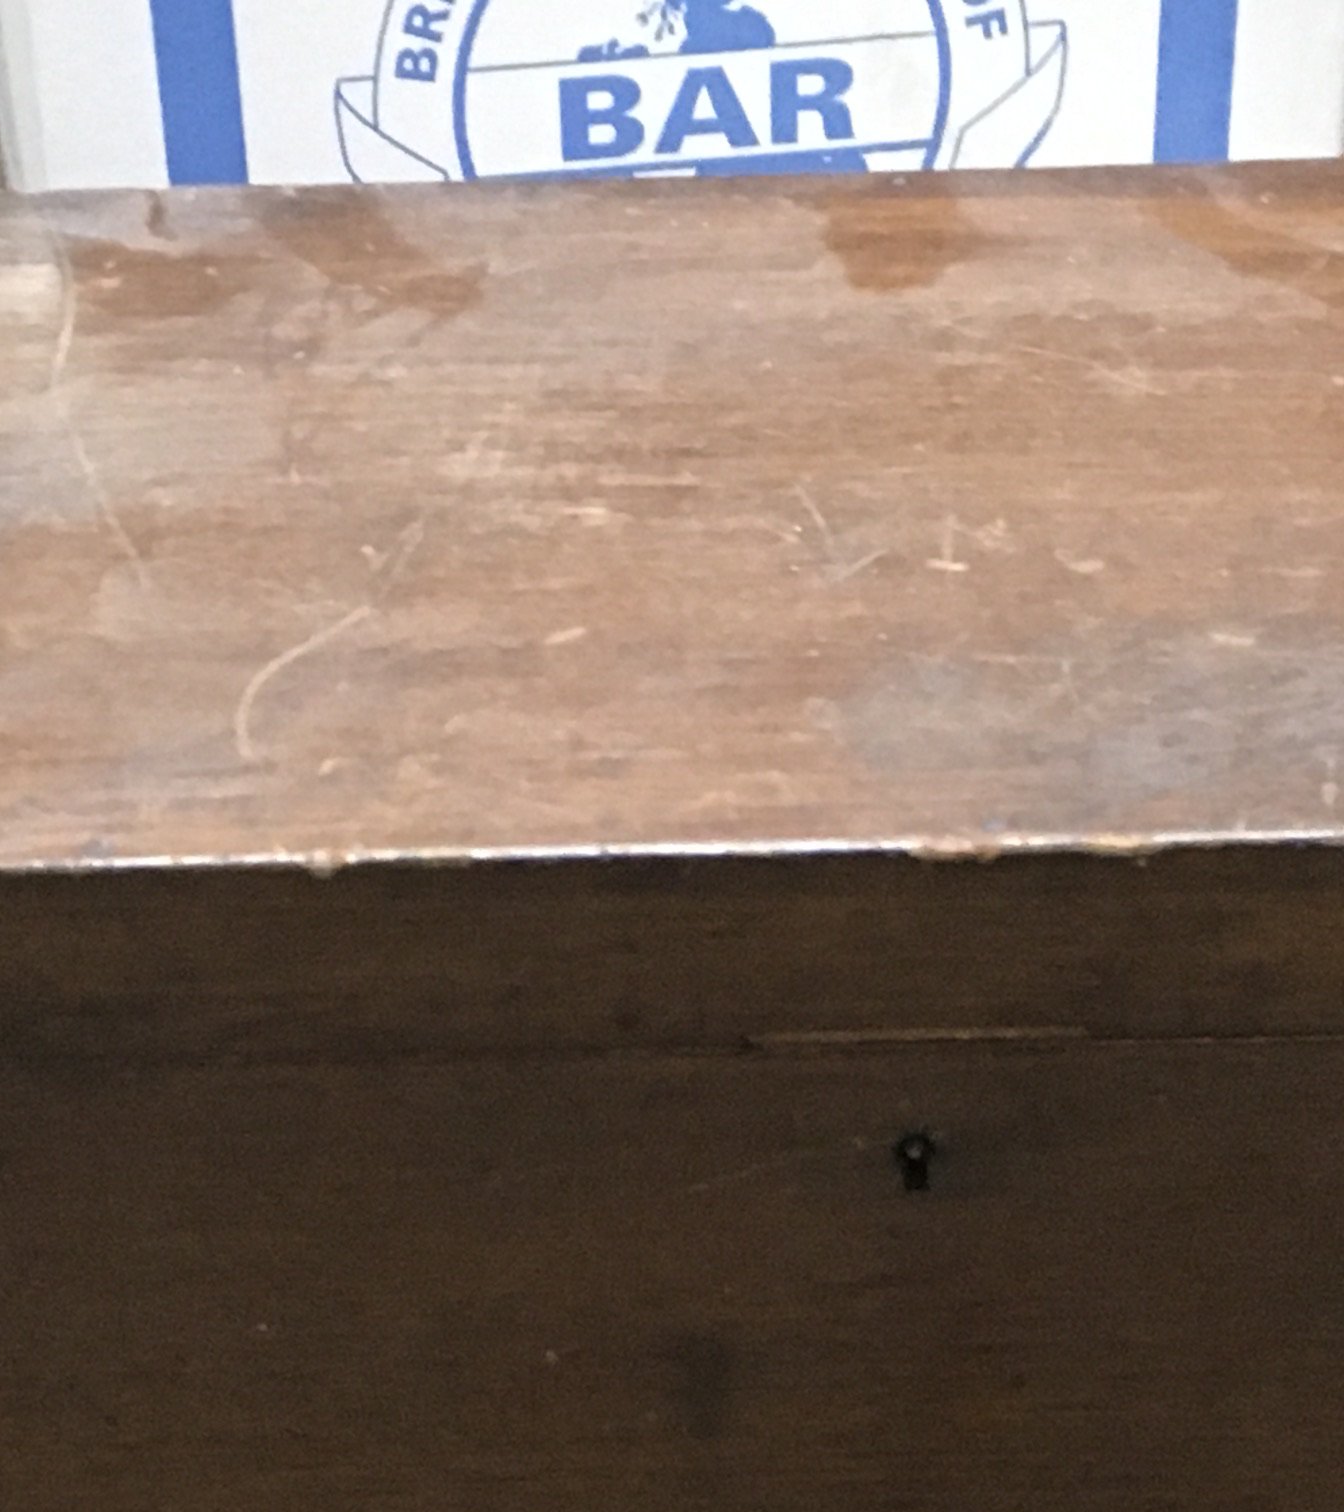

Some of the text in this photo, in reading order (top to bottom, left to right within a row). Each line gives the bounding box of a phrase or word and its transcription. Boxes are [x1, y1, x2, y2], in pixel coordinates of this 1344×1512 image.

[394, 0, 1009, 82] BR F
[558, 57, 855, 162] BAR
